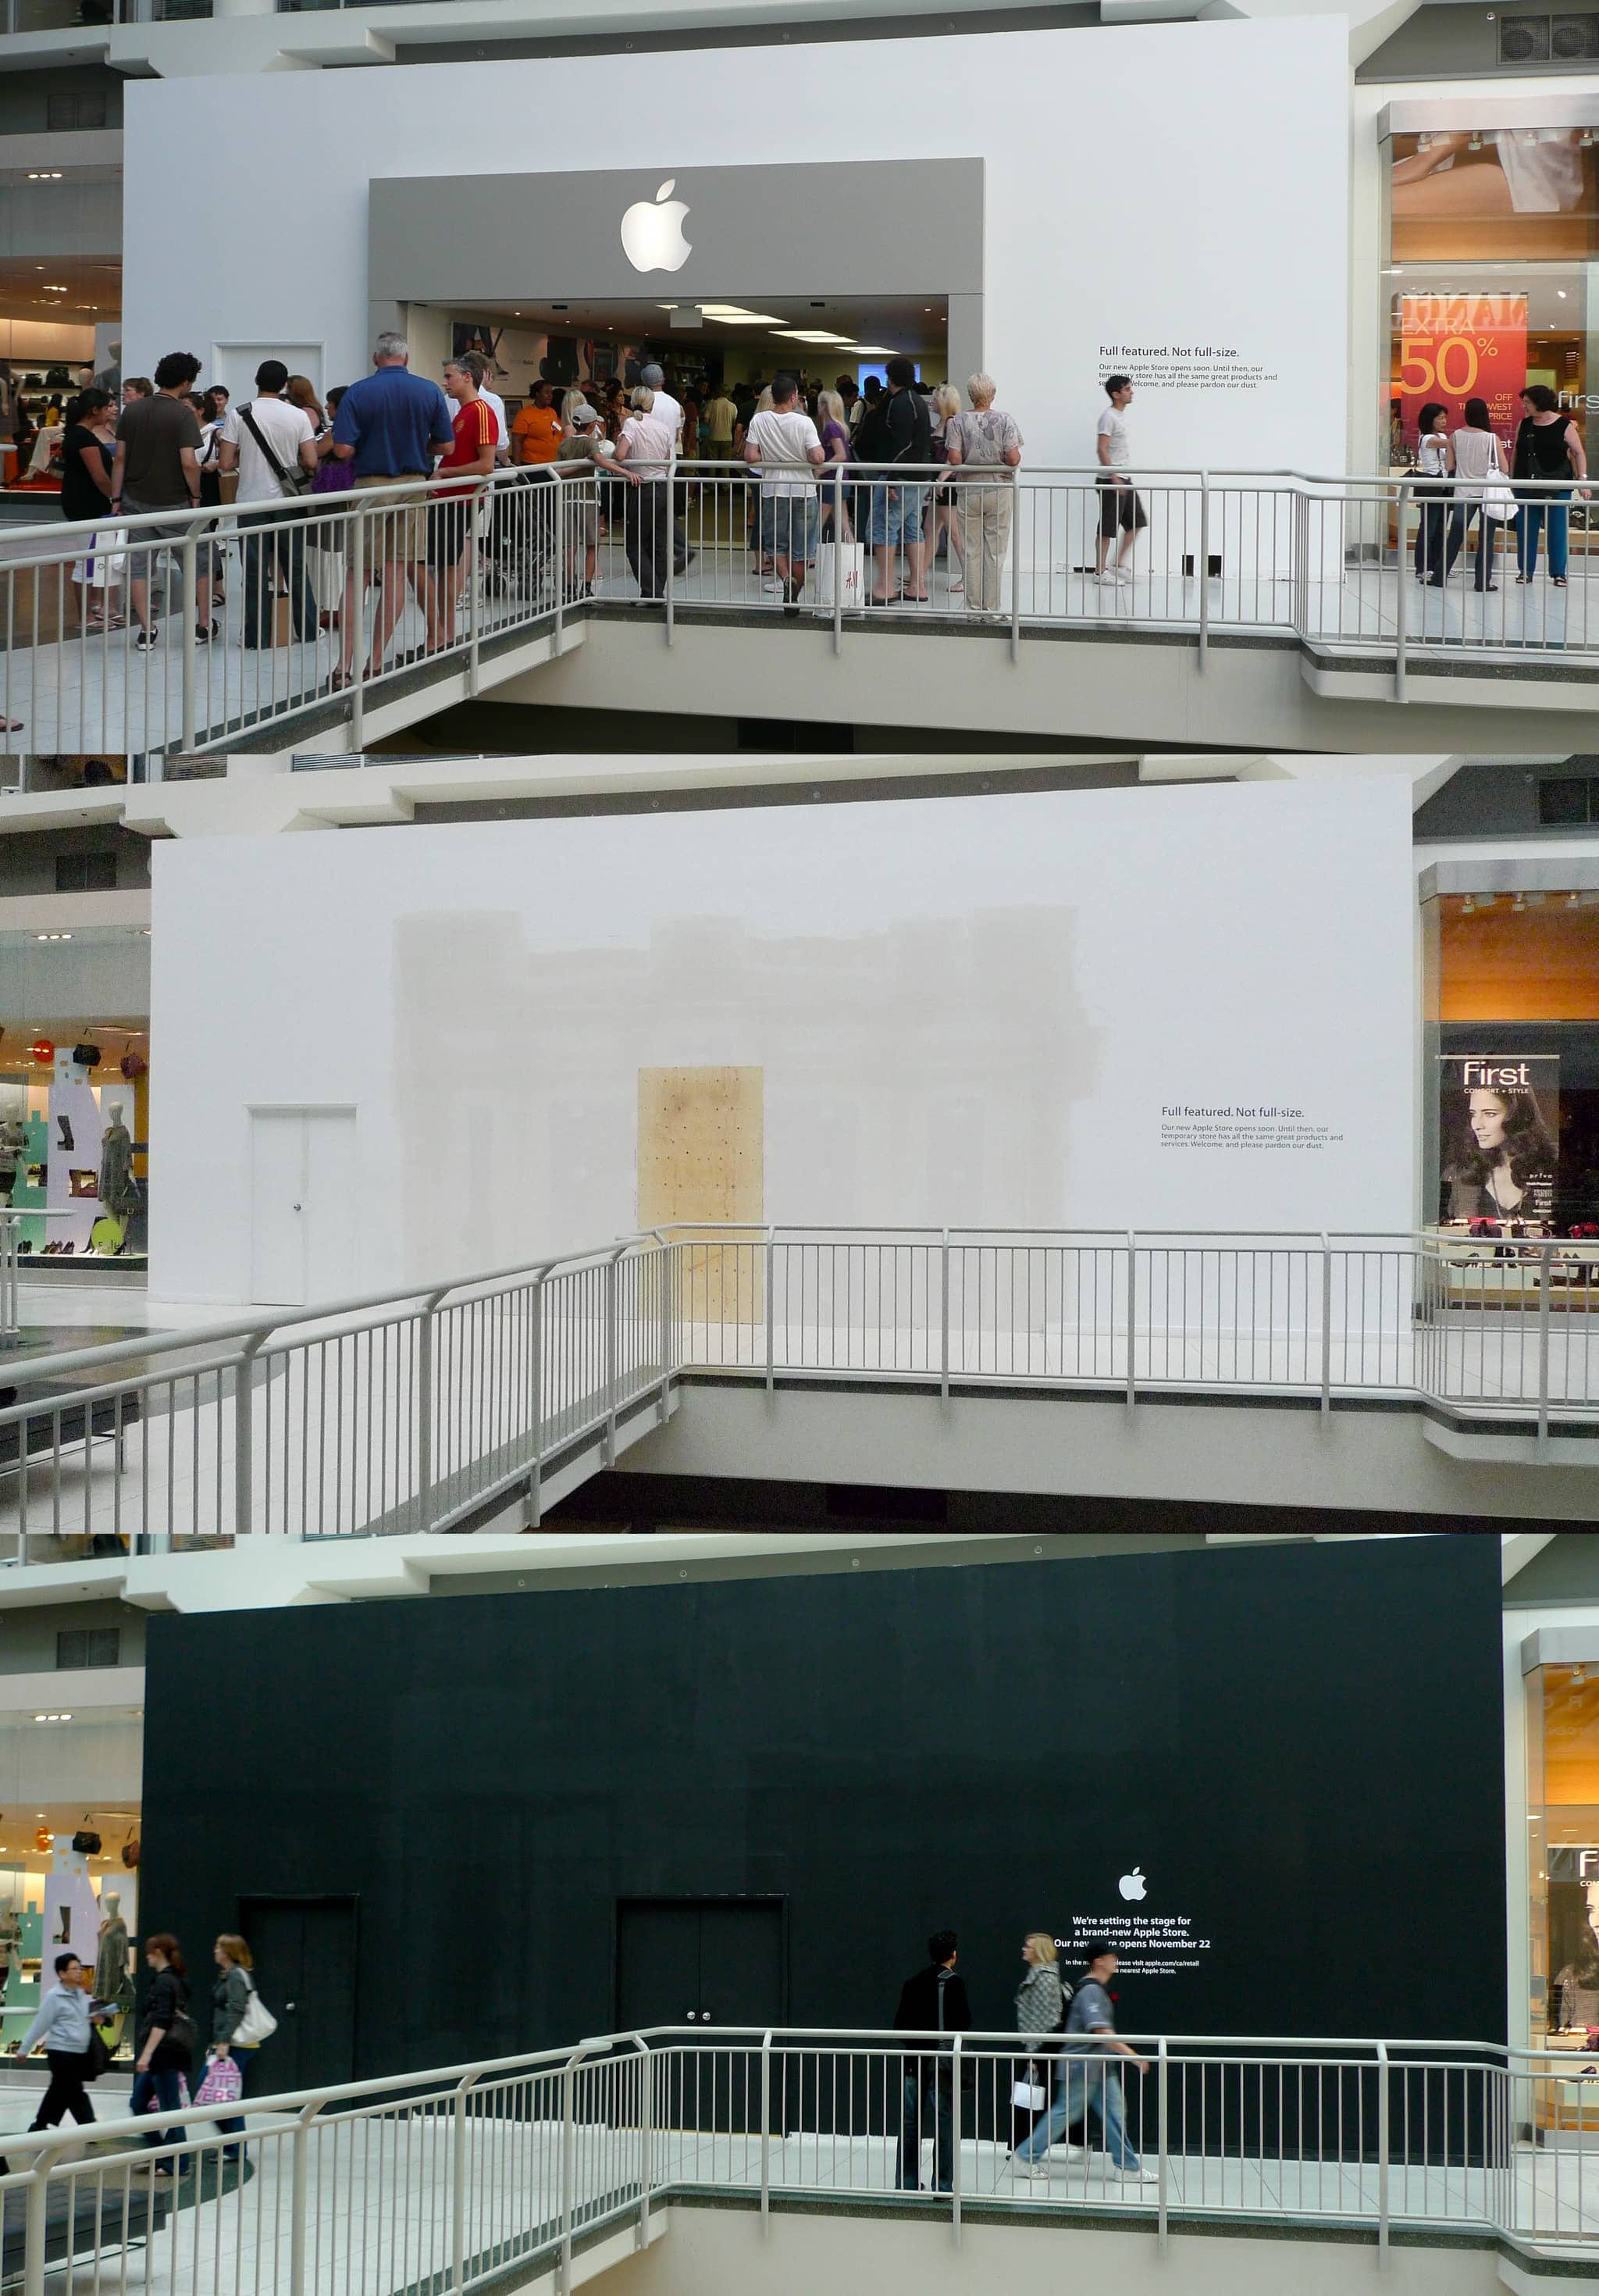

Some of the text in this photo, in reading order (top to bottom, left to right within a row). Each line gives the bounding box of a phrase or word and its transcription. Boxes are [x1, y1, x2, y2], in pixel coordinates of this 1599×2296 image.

[1401, 318, 1476, 335] EXTRA
[1099, 346, 1239, 357] Full featured. Not full-size.
[1464, 1061, 1530, 1086] First
[1162, 1107, 1305, 1118] Full featured. Not full-size.
[1073, 1916, 1191, 1927] We're setting the stage for
[1082, 1927, 1131, 1936] brand-new
[1133, 1928, 1160, 1938] Apple
[1163, 1928, 1189, 1937] Store.
[1054, 1939, 1071, 1948] Our
[1149, 1939, 1197, 1948] November
[1145, 1959, 1200, 1968] apple.com/ca/retail
